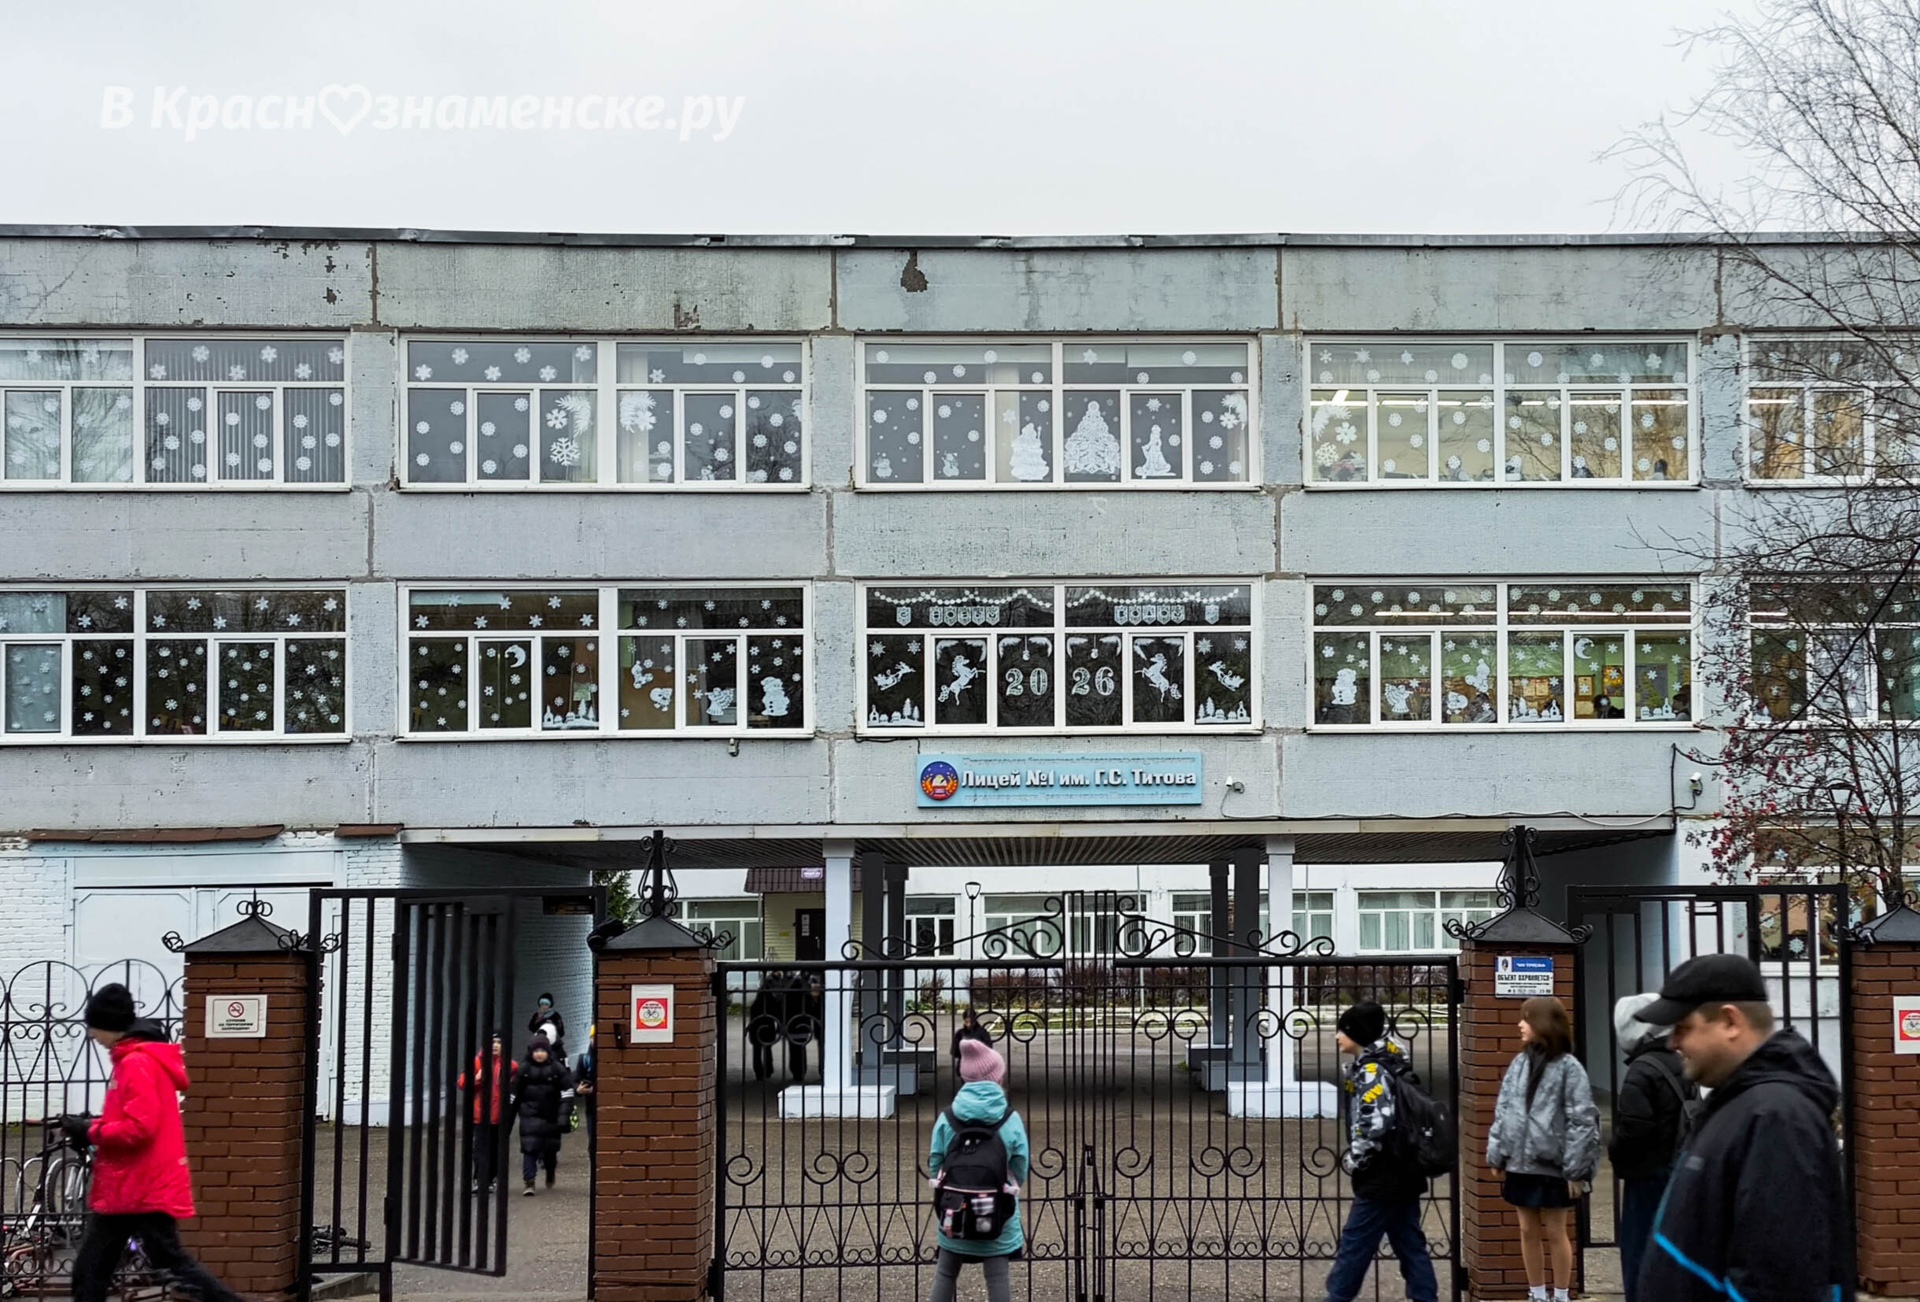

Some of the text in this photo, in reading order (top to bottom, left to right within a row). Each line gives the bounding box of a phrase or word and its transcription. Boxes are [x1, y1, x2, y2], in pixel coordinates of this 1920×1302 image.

[961, 769, 1021, 790] Лицей
[1059, 773, 1090, 787] им.
[1094, 768, 1128, 786] Г.С.
[1131, 768, 1197, 786] Титова
